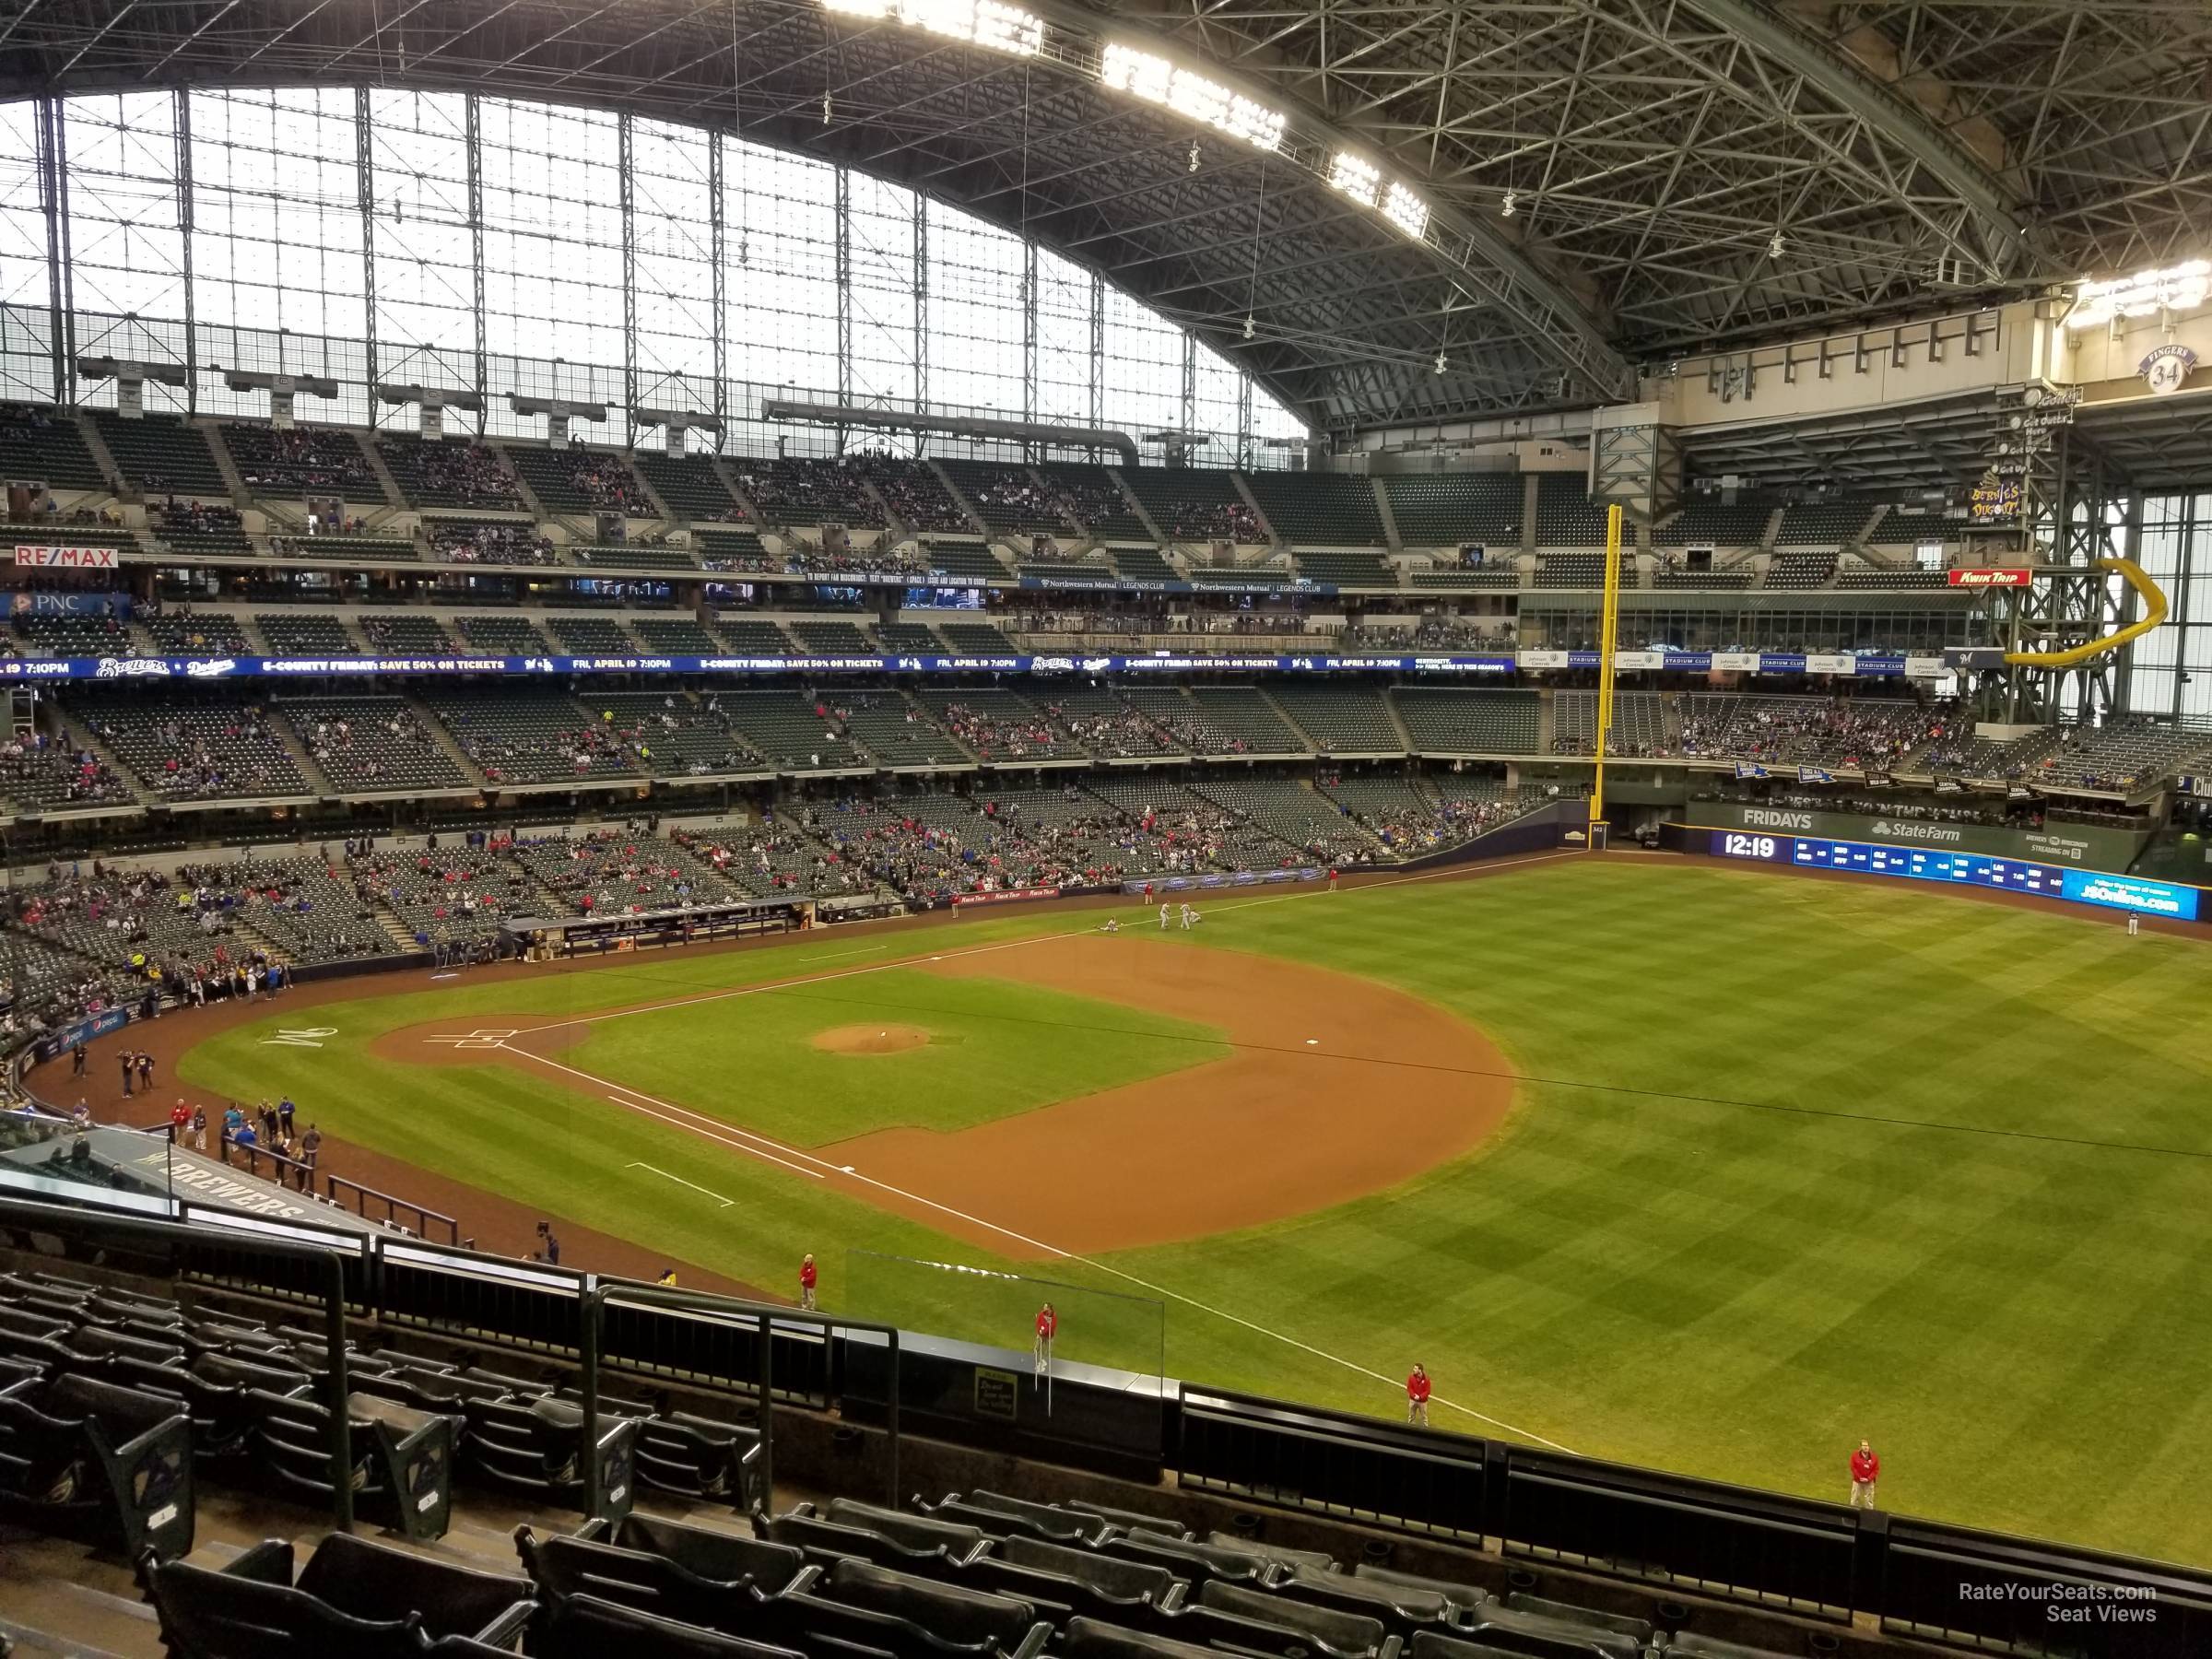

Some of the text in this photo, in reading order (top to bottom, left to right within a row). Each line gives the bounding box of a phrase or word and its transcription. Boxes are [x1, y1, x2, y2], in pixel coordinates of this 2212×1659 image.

[2148, 346, 2188, 362] FINGERS
[2153, 363, 2178, 387] 34
[1971, 484, 2019, 503] BERNIE'S
[17, 547, 112, 566] RE/MAX
[1960, 572, 2018, 582] KWIK TRIP
[37, 595, 79, 610] PNC
[6, 664, 21, 673] 19
[26, 663, 69, 673] 7:10PM
[97, 657, 171, 677] Brewers
[380, 661, 410, 669] SAVE
[412, 661, 436, 669] 50%
[438, 661, 454, 669] ON
[456, 660, 505, 669] TICKETS
[594, 660, 624, 668] APRIL
[640, 659, 671, 668] 7:10PM
[1244, 659, 1278, 667] TICKETS
[1744, 809, 1812, 829] FRIDAYS
[1725, 834, 1774, 857] 12:19
[2080, 885, 2179, 912] JSOnline.com
[101, 1016, 118, 1030] pepsi
